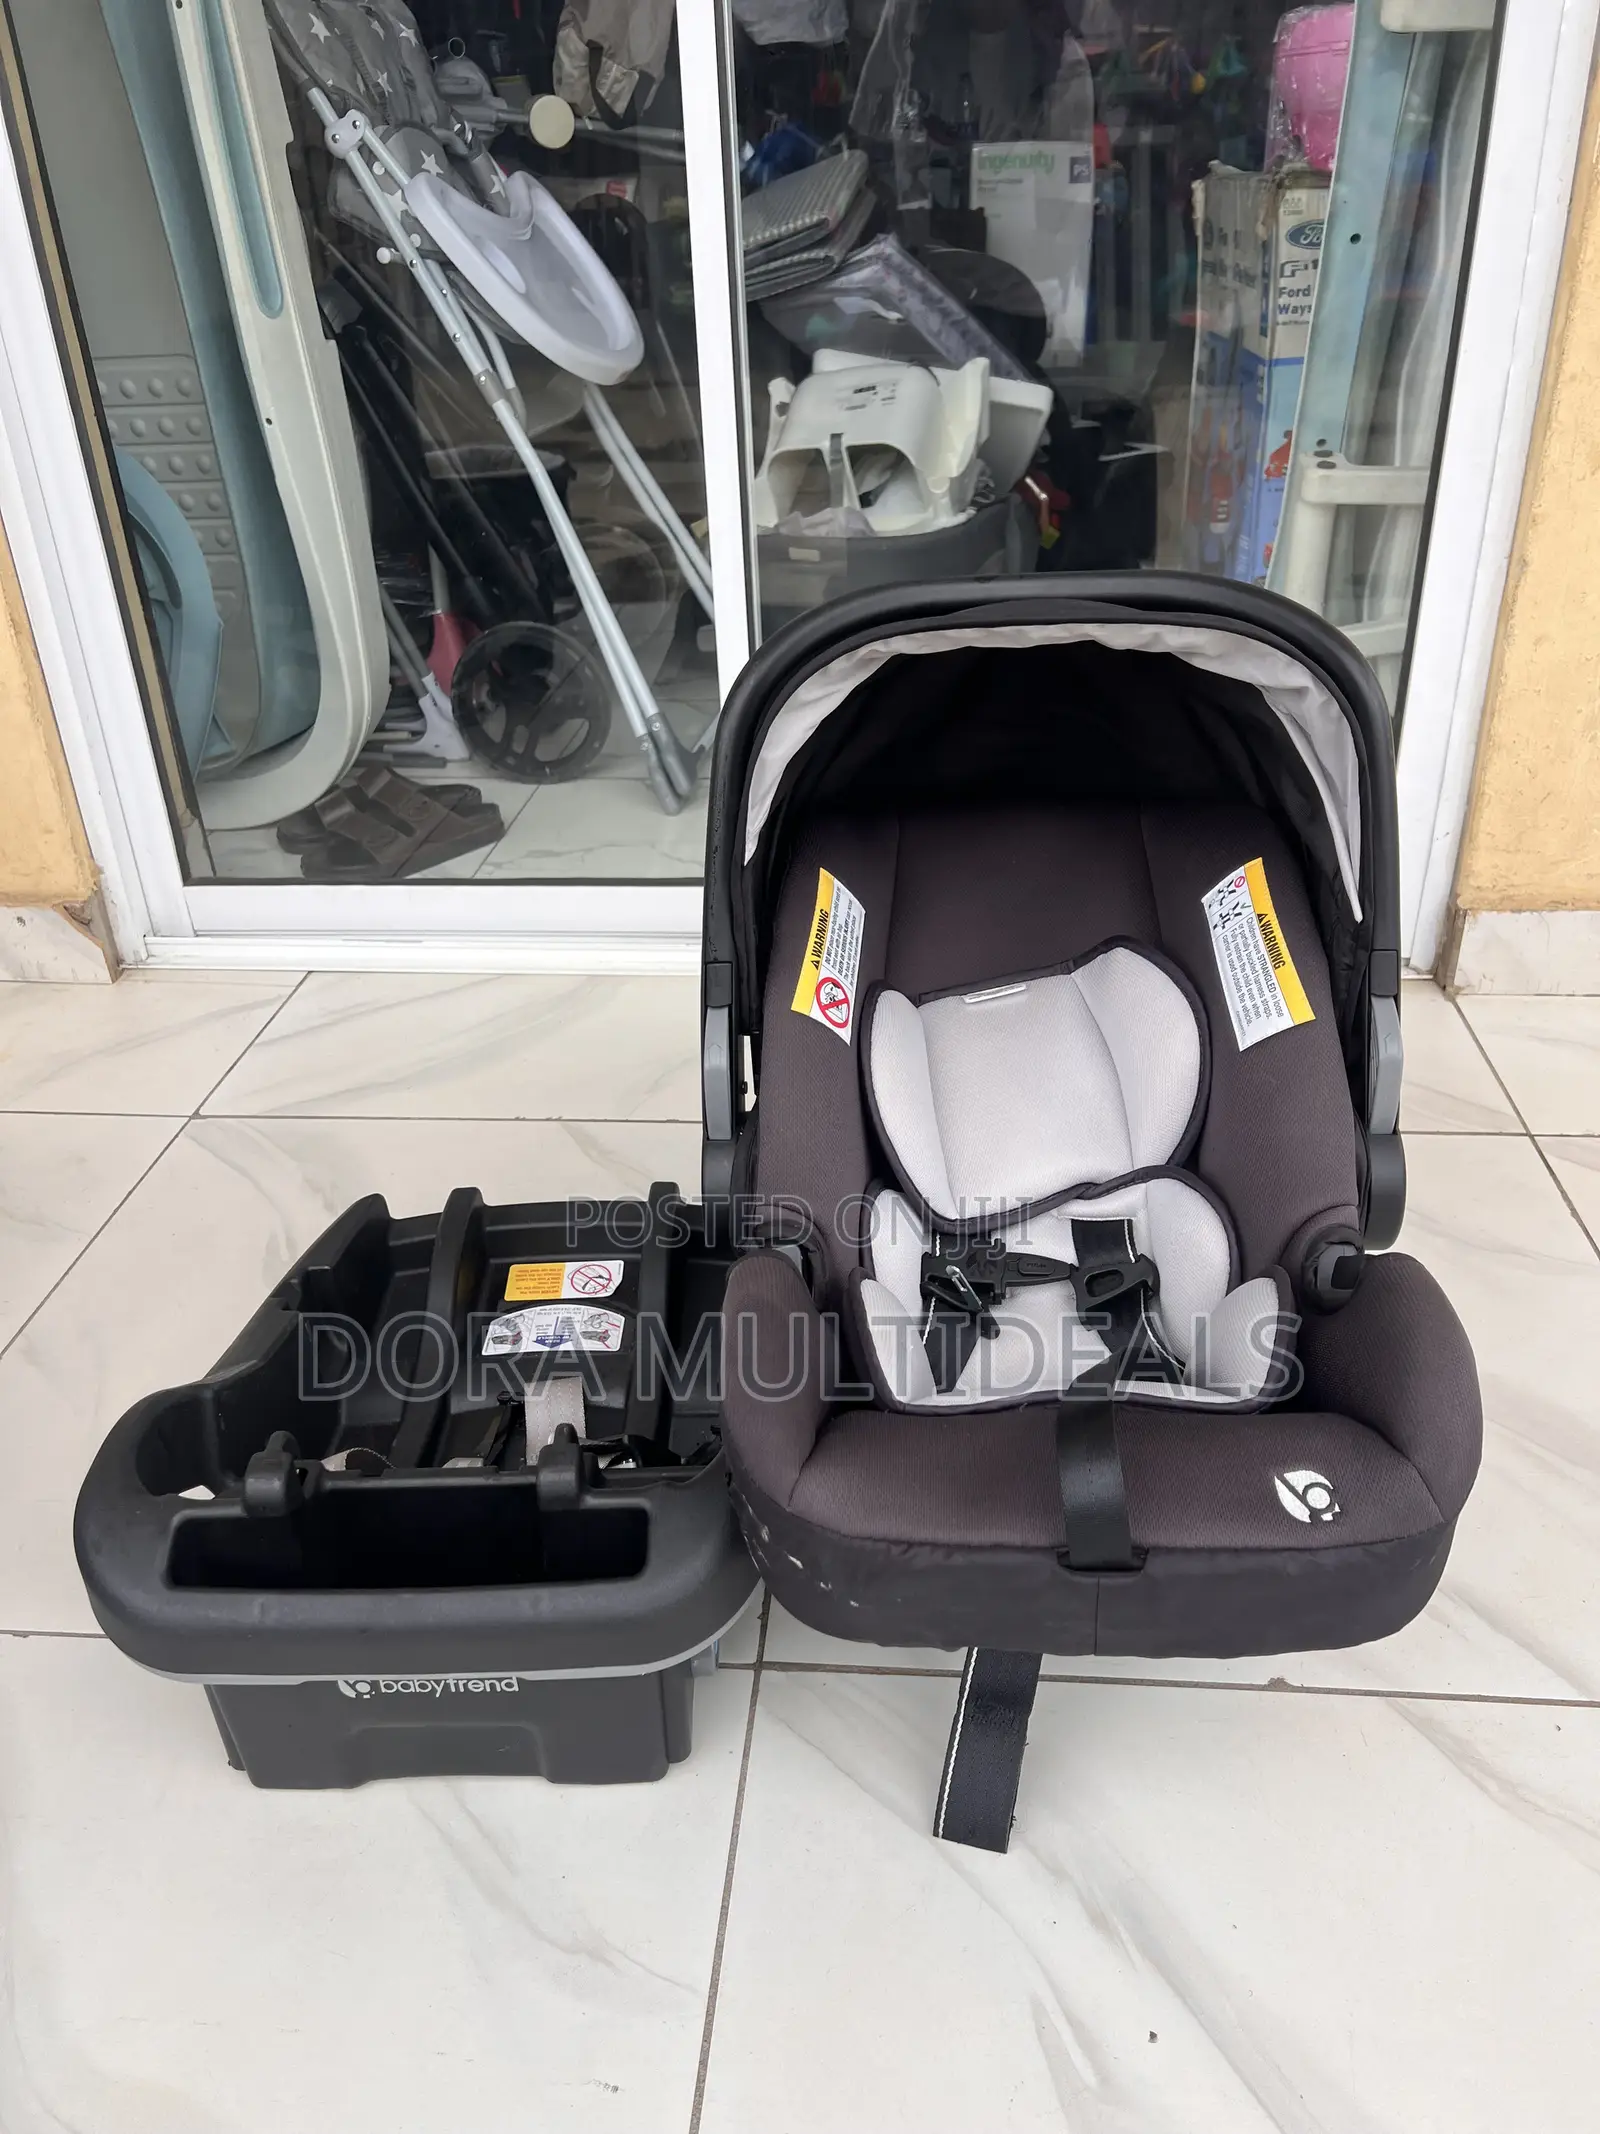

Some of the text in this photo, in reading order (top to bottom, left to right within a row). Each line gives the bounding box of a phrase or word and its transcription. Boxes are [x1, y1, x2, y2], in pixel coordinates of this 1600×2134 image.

[1278, 284, 1312, 298] Ford
[811, 909, 828, 961] WARNING
[1223, 935, 1231, 952] carrier
[1230, 928, 1239, 943] Fully
[1234, 942, 1244, 963] restrain
[1260, 920, 1285, 970] WARNING
[1228, 958, 1237, 972] used
[1246, 917, 1256, 941] Children
[1253, 939, 1261, 955] have
[1257, 954, 1276, 993] STRANGLED
[1273, 999, 1284, 1017] loose
[1232, 972, 1243, 993] outside
[1238, 930, 1250, 952] partially
[1246, 951, 1259, 975] buckled
[1253, 974, 1265, 998] harness
[1261, 998, 1272, 1019] straps.
[1242, 973, 1253, 988] child
[1247, 988, 1255, 1002] even
[1252, 1002, 1261, 1019] when
